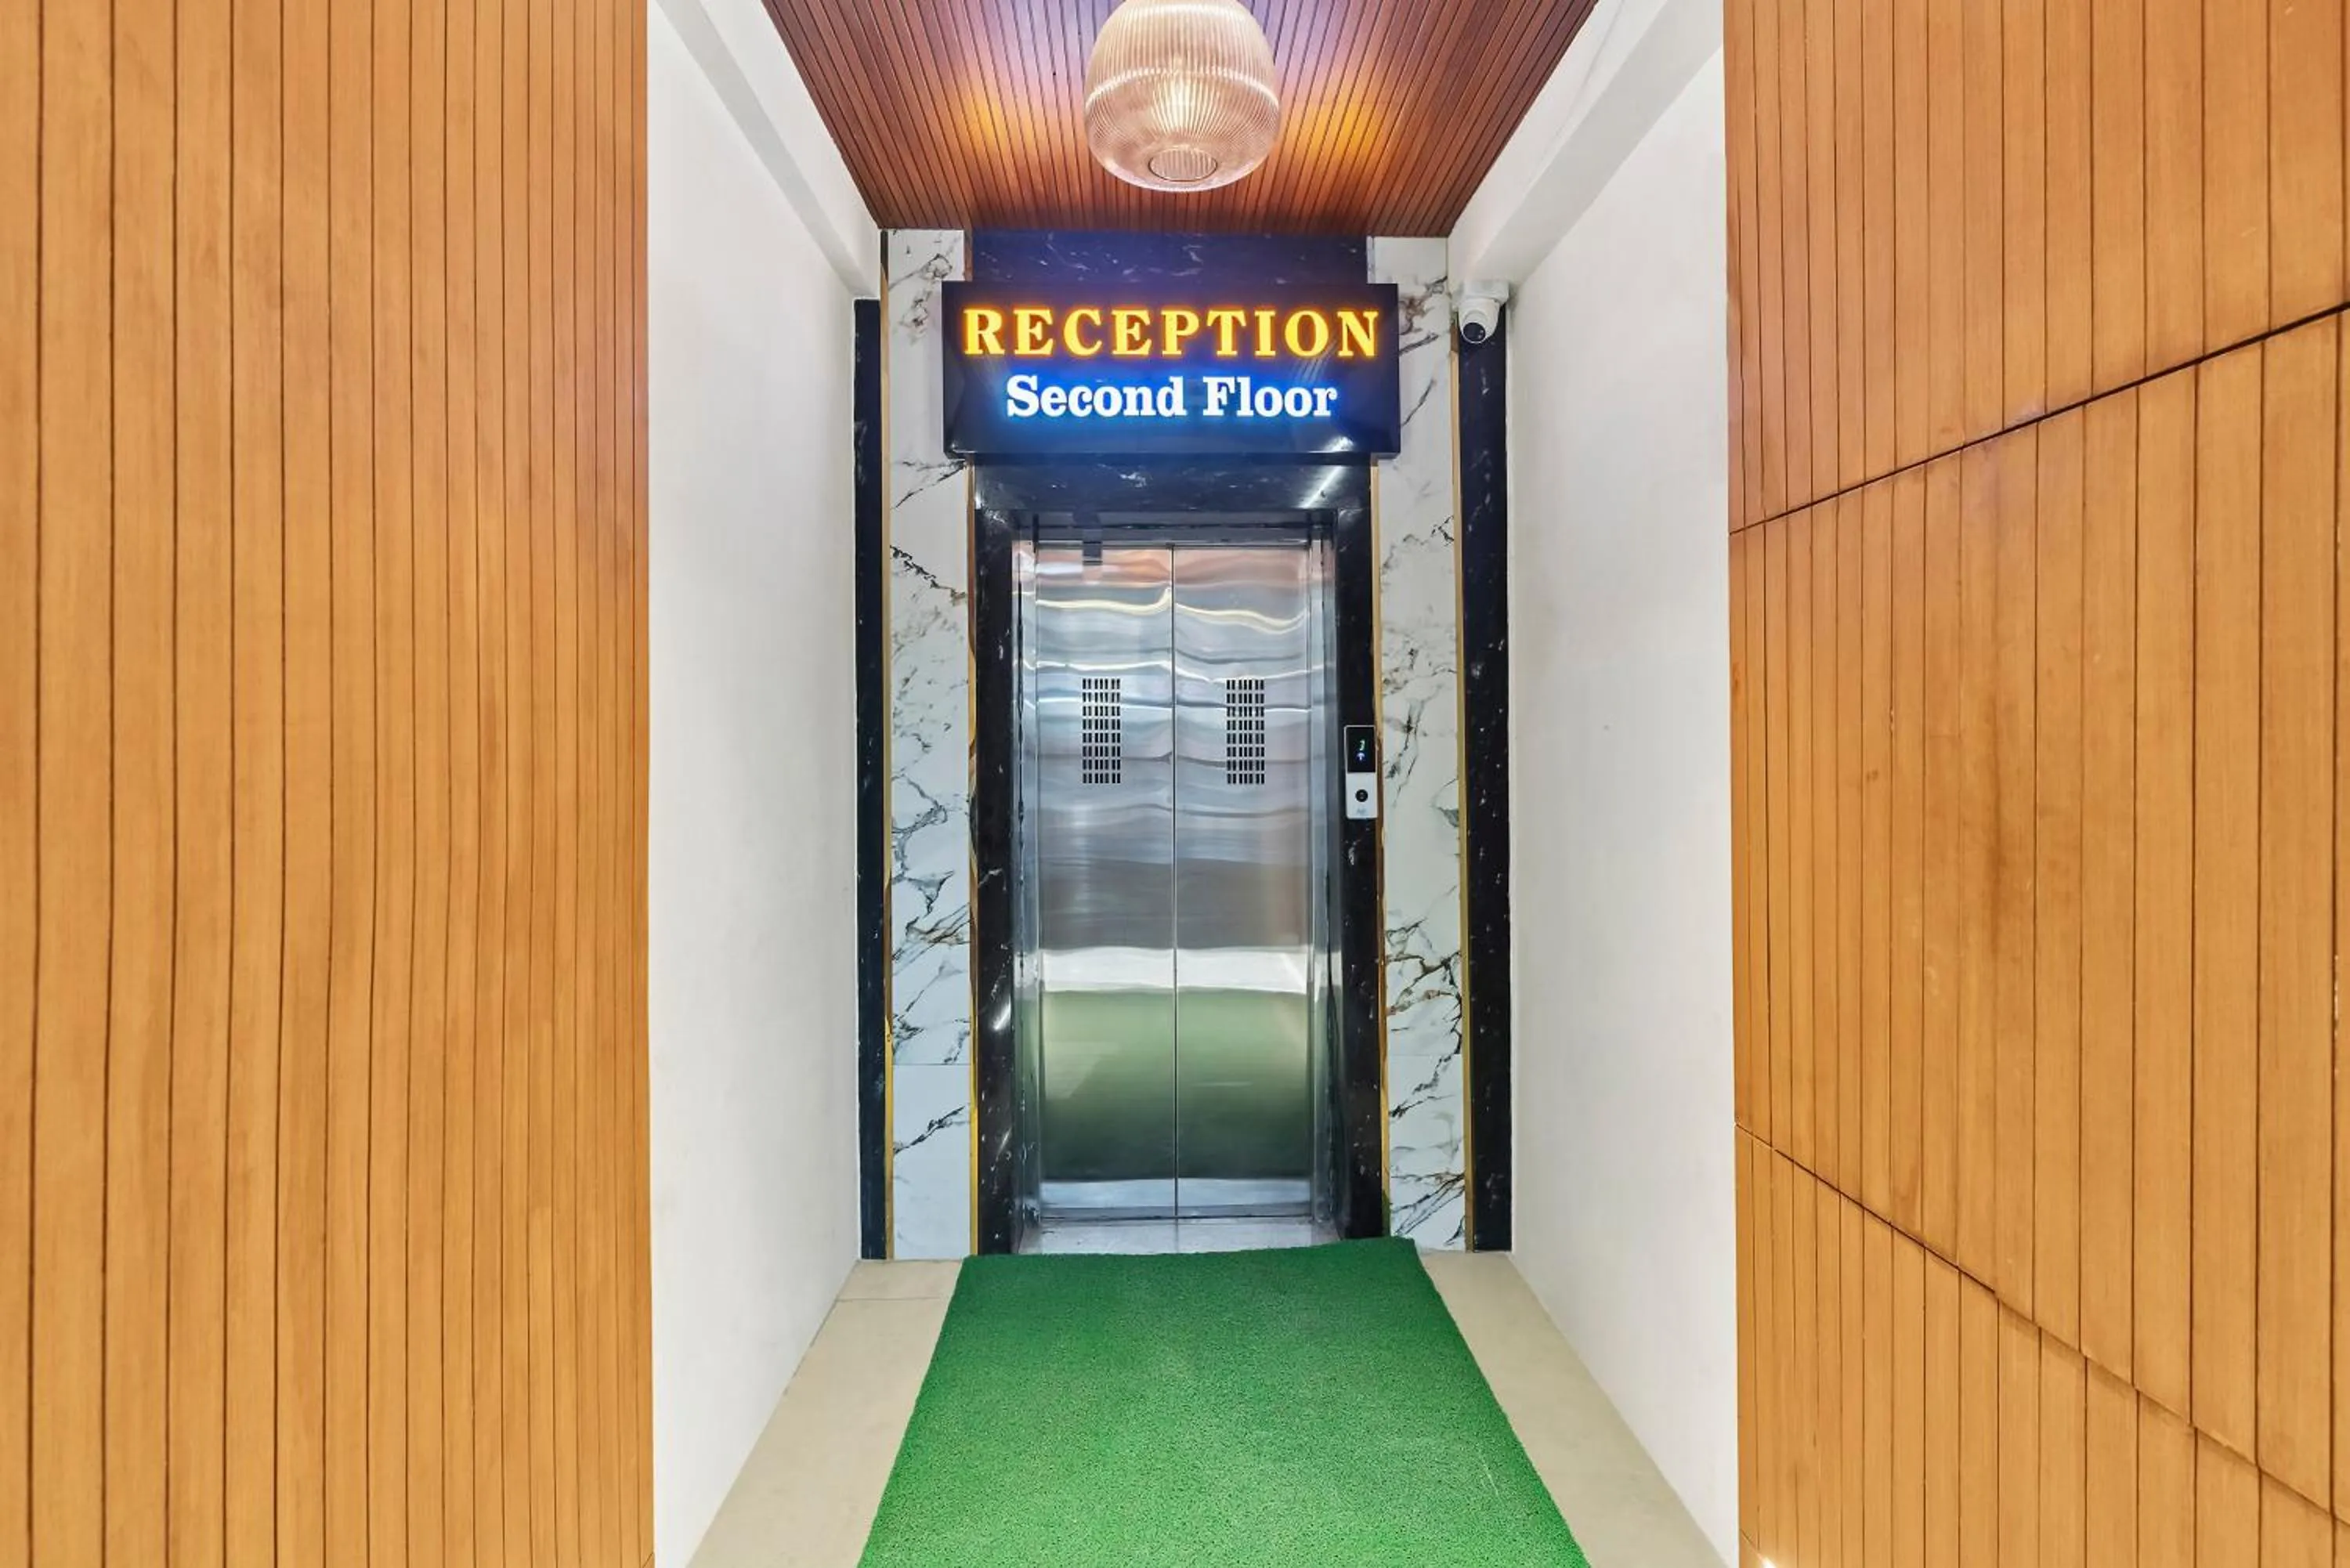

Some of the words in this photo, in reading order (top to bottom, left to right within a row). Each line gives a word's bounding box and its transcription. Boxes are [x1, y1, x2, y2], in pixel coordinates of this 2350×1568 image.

[964, 308, 1379, 357] RECEPTION
[1006, 374, 1187, 417] Second
[1202, 376, 1337, 417] Floor
